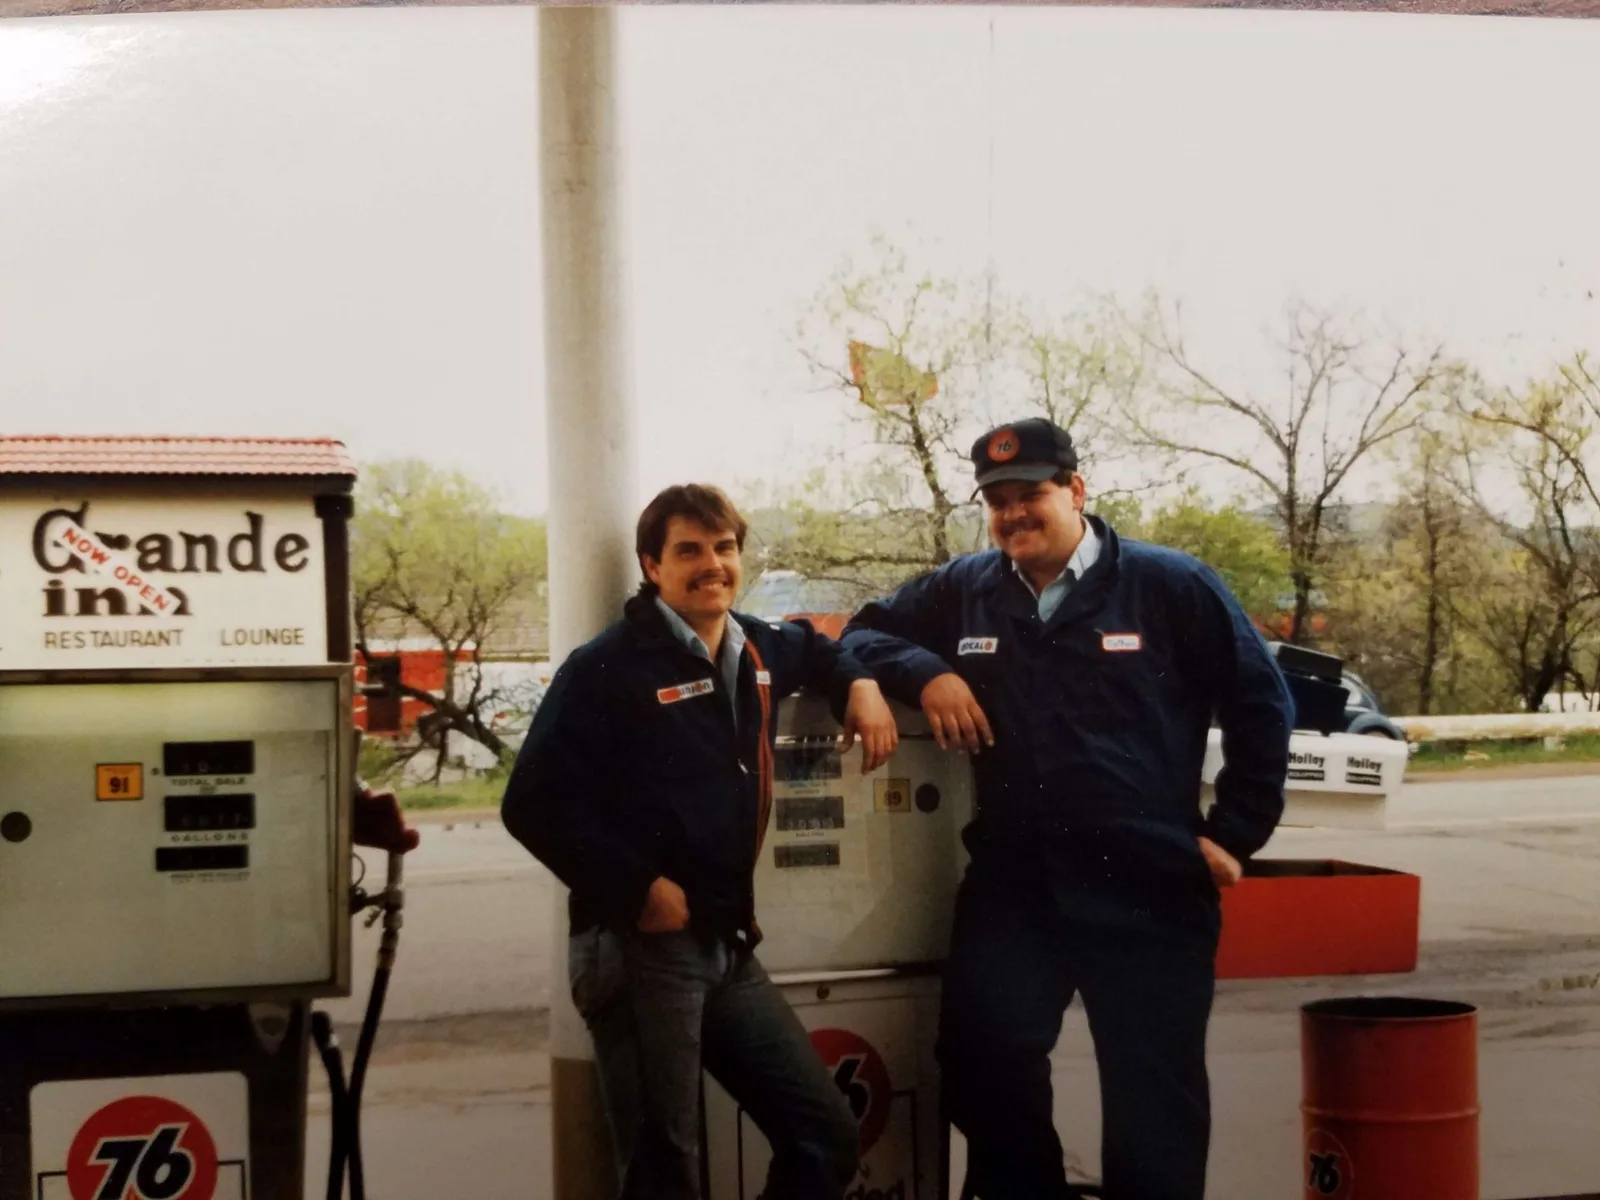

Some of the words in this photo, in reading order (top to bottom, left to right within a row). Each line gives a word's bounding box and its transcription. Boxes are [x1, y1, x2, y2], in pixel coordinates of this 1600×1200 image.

[62, 527, 110, 566] NOW
[113, 565, 171, 611] OPEN
[45, 629, 184, 649] RESTAURANT
[220, 628, 305, 646] LOUNGE
[109, 776, 130, 793] 91
[171, 832, 249, 842] GALLONS
[90, 1123, 194, 1200] 76
[1308, 1151, 1341, 1194] 76
